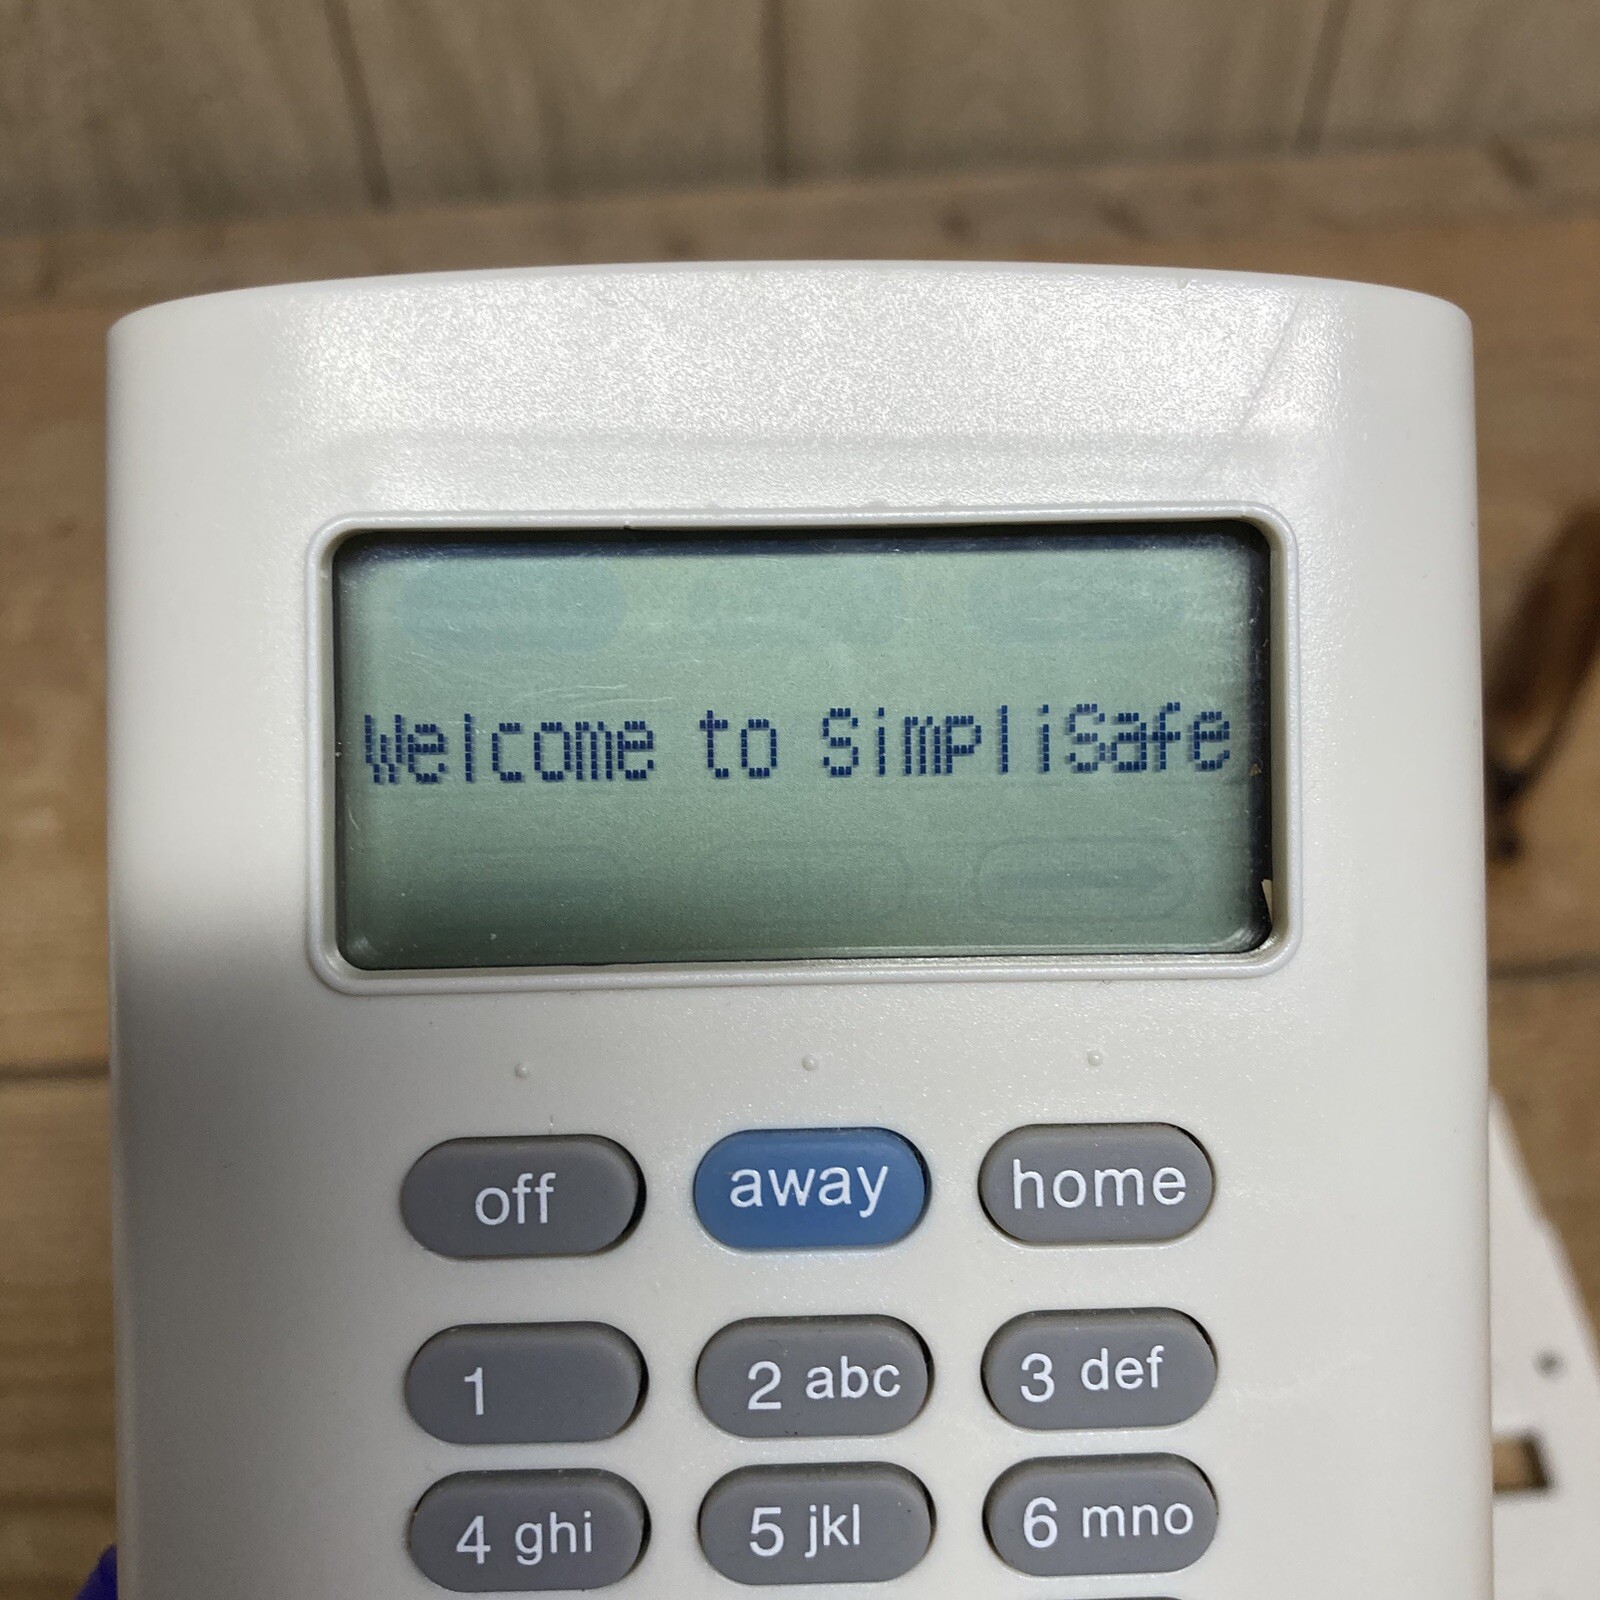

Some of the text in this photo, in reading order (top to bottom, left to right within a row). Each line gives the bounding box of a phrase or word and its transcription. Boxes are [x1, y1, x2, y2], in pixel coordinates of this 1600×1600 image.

[364, 702, 1231, 784] Welcome to SimpliSafe
[475, 1172, 557, 1226] off
[730, 1165, 889, 1218] away
[1012, 1158, 1188, 1210] home
[463, 1366, 485, 1416] 1
[747, 1355, 902, 1410] 2 abc
[1020, 1345, 1165, 1403] 3 def
[456, 1510, 593, 1566] 4 ghi
[749, 1503, 861, 1558] 5 jkl
[1023, 1496, 1194, 1549] 6 mno
